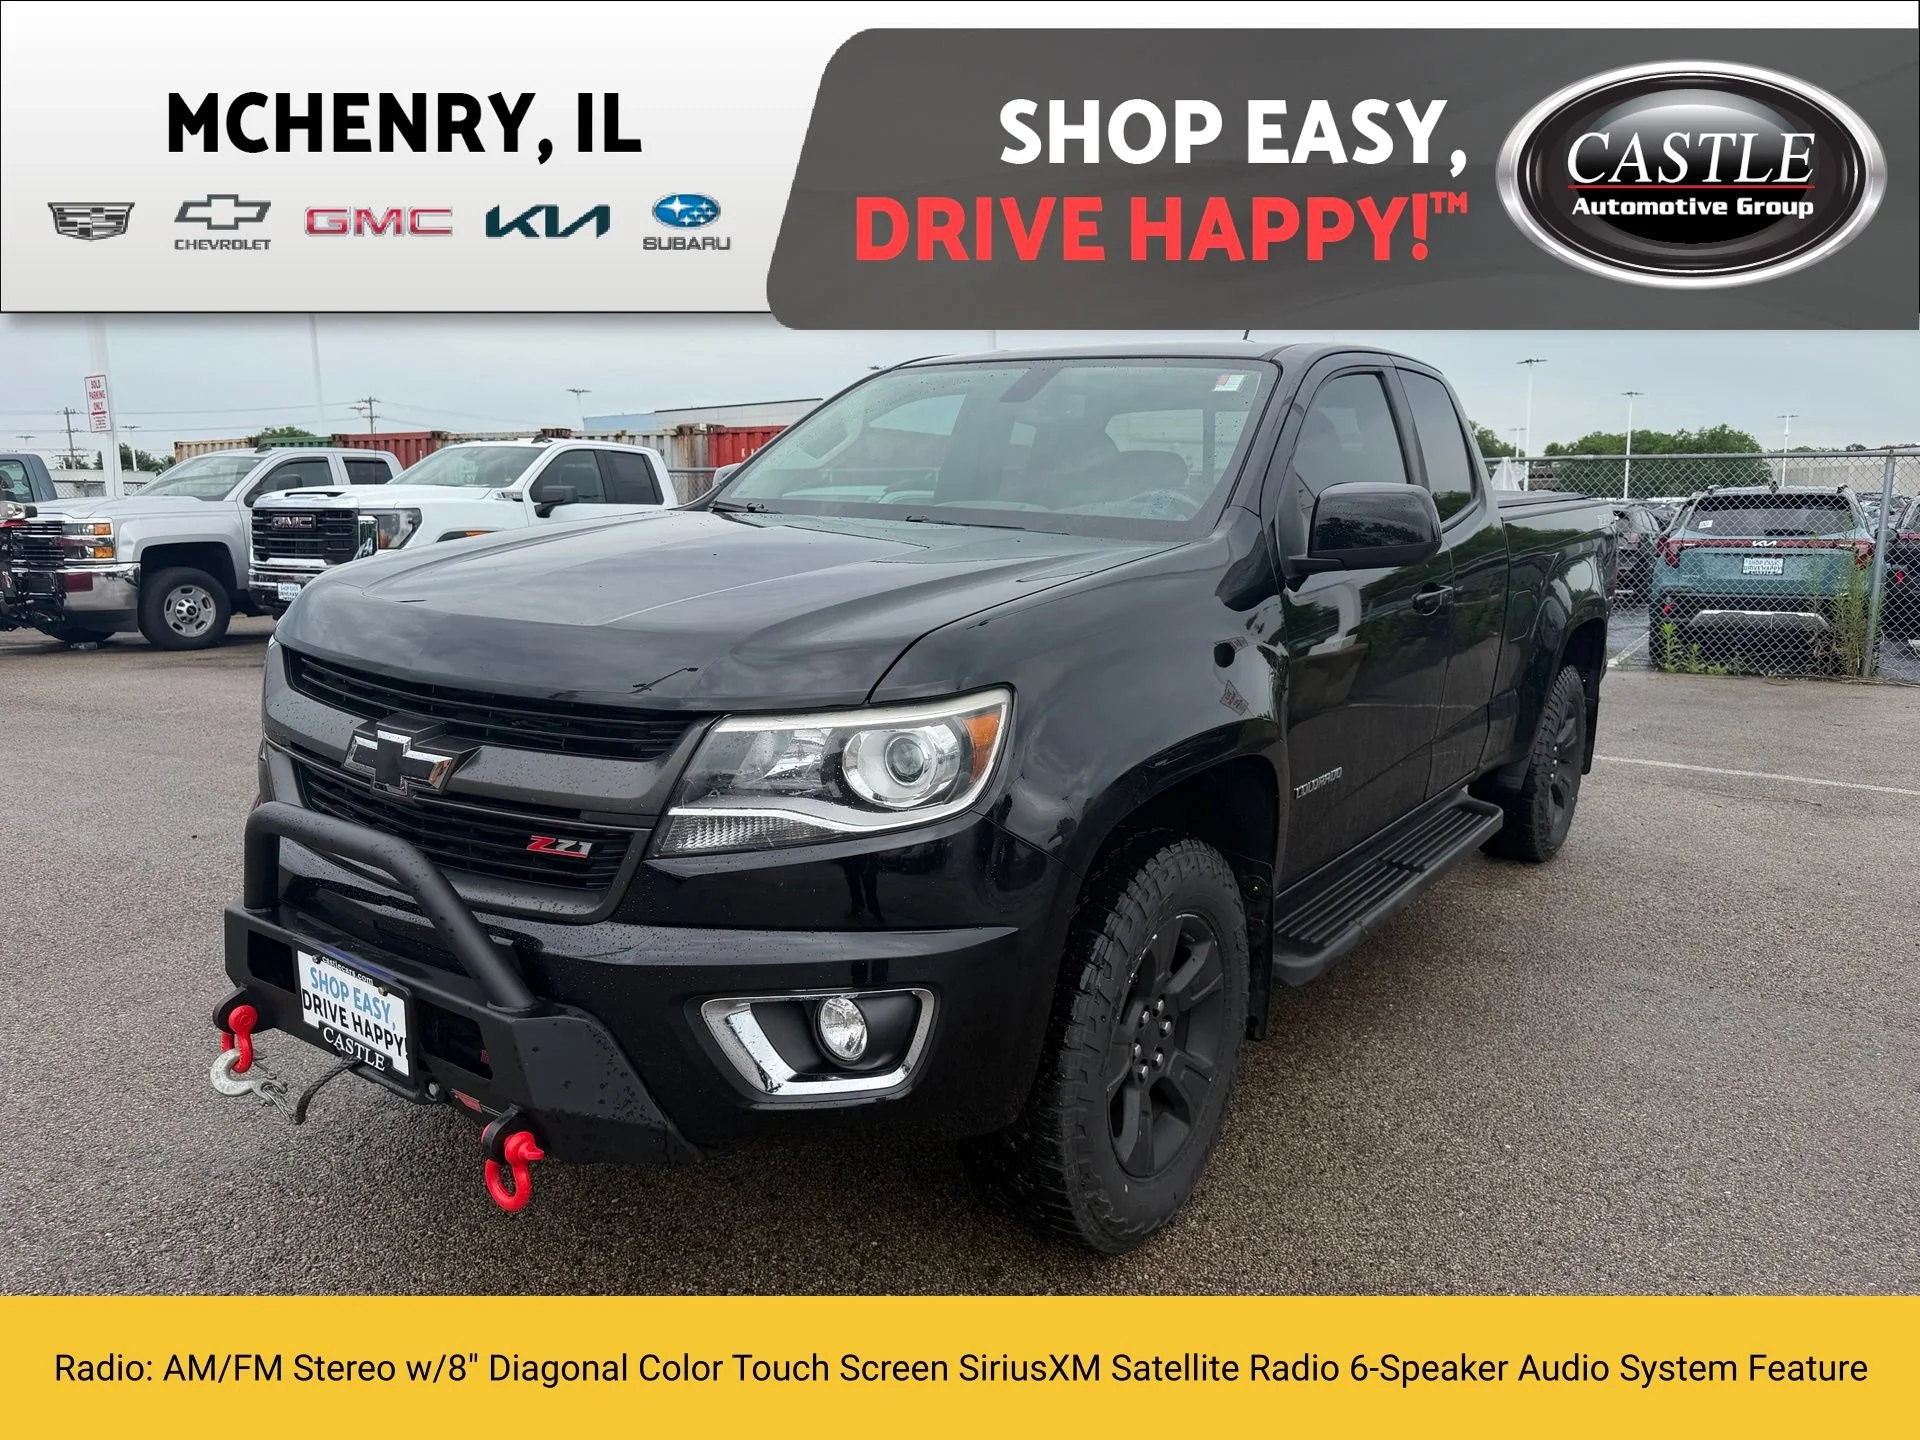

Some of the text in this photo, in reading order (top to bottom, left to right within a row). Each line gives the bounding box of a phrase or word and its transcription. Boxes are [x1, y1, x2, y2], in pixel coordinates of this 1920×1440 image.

[272, 516, 313, 528] GMC
[1293, 766, 1343, 799] COLORADO
[526, 834, 593, 859] Z71
[321, 955, 375, 987] castlecars.com
[301, 988, 350, 1030] DRIVE
[310, 966, 396, 1031] SHOP EASY,
[323, 1026, 386, 1072] CASTLE
